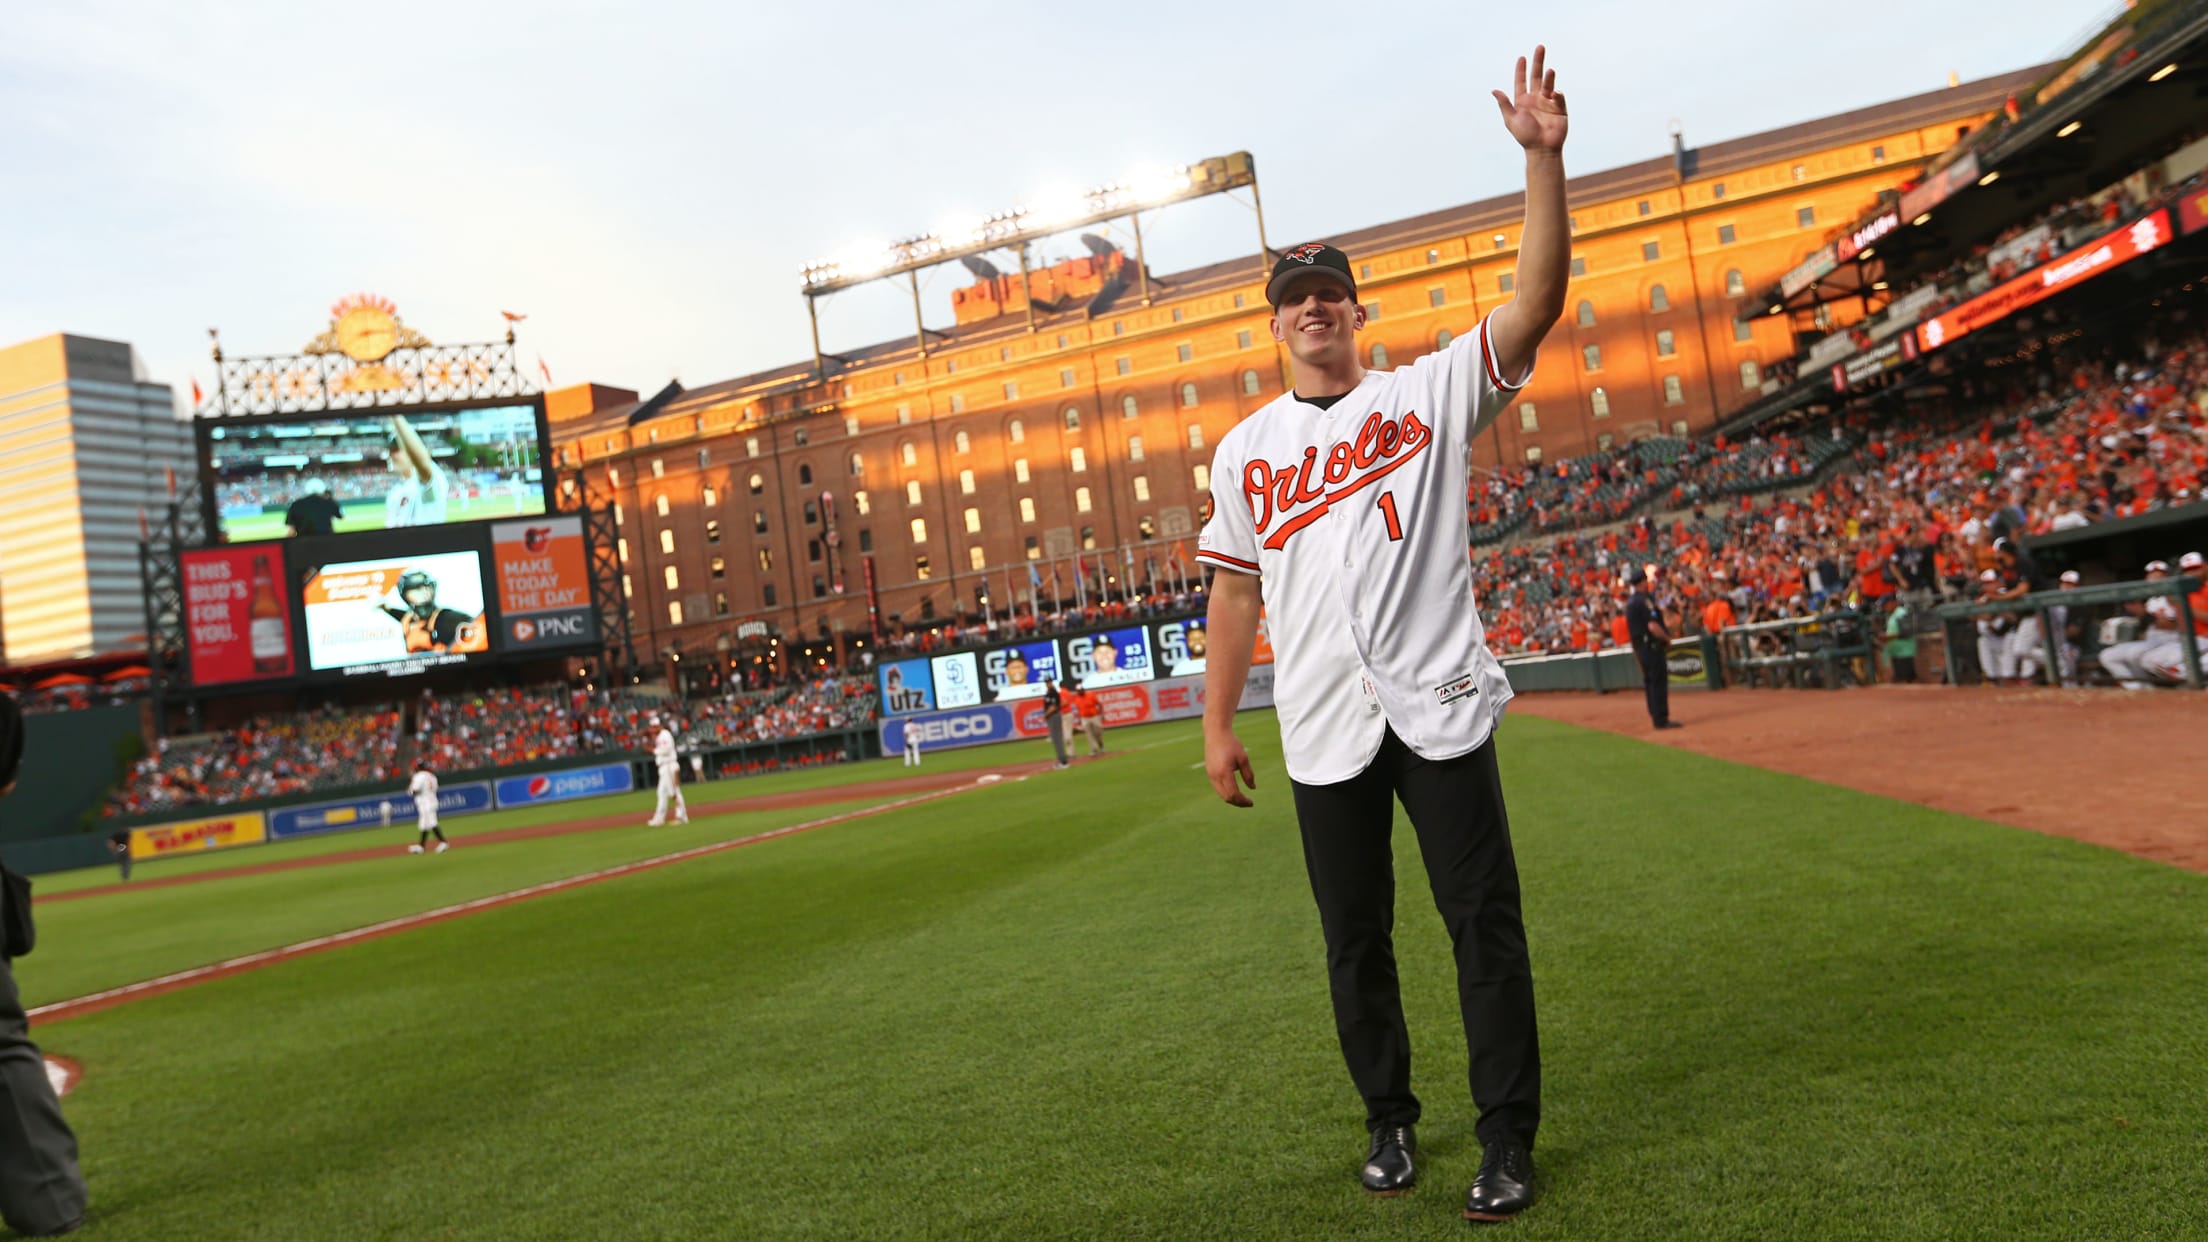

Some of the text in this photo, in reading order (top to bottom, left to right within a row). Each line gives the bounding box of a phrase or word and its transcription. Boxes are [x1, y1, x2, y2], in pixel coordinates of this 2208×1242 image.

[1243, 410, 1431, 535] Orioles
[1377, 491, 1404, 542] 1
[187, 560, 231, 581] THIS
[503, 557, 552, 577] MAKE
[189, 580, 248, 603] BUD'S
[506, 573, 559, 593] TODAY
[508, 588, 577, 609] THE DAY
[191, 603, 230, 624] FOR
[193, 624, 239, 644] YOU.
[538, 615, 584, 637] PNC
[555, 771, 605, 794] pepsi
